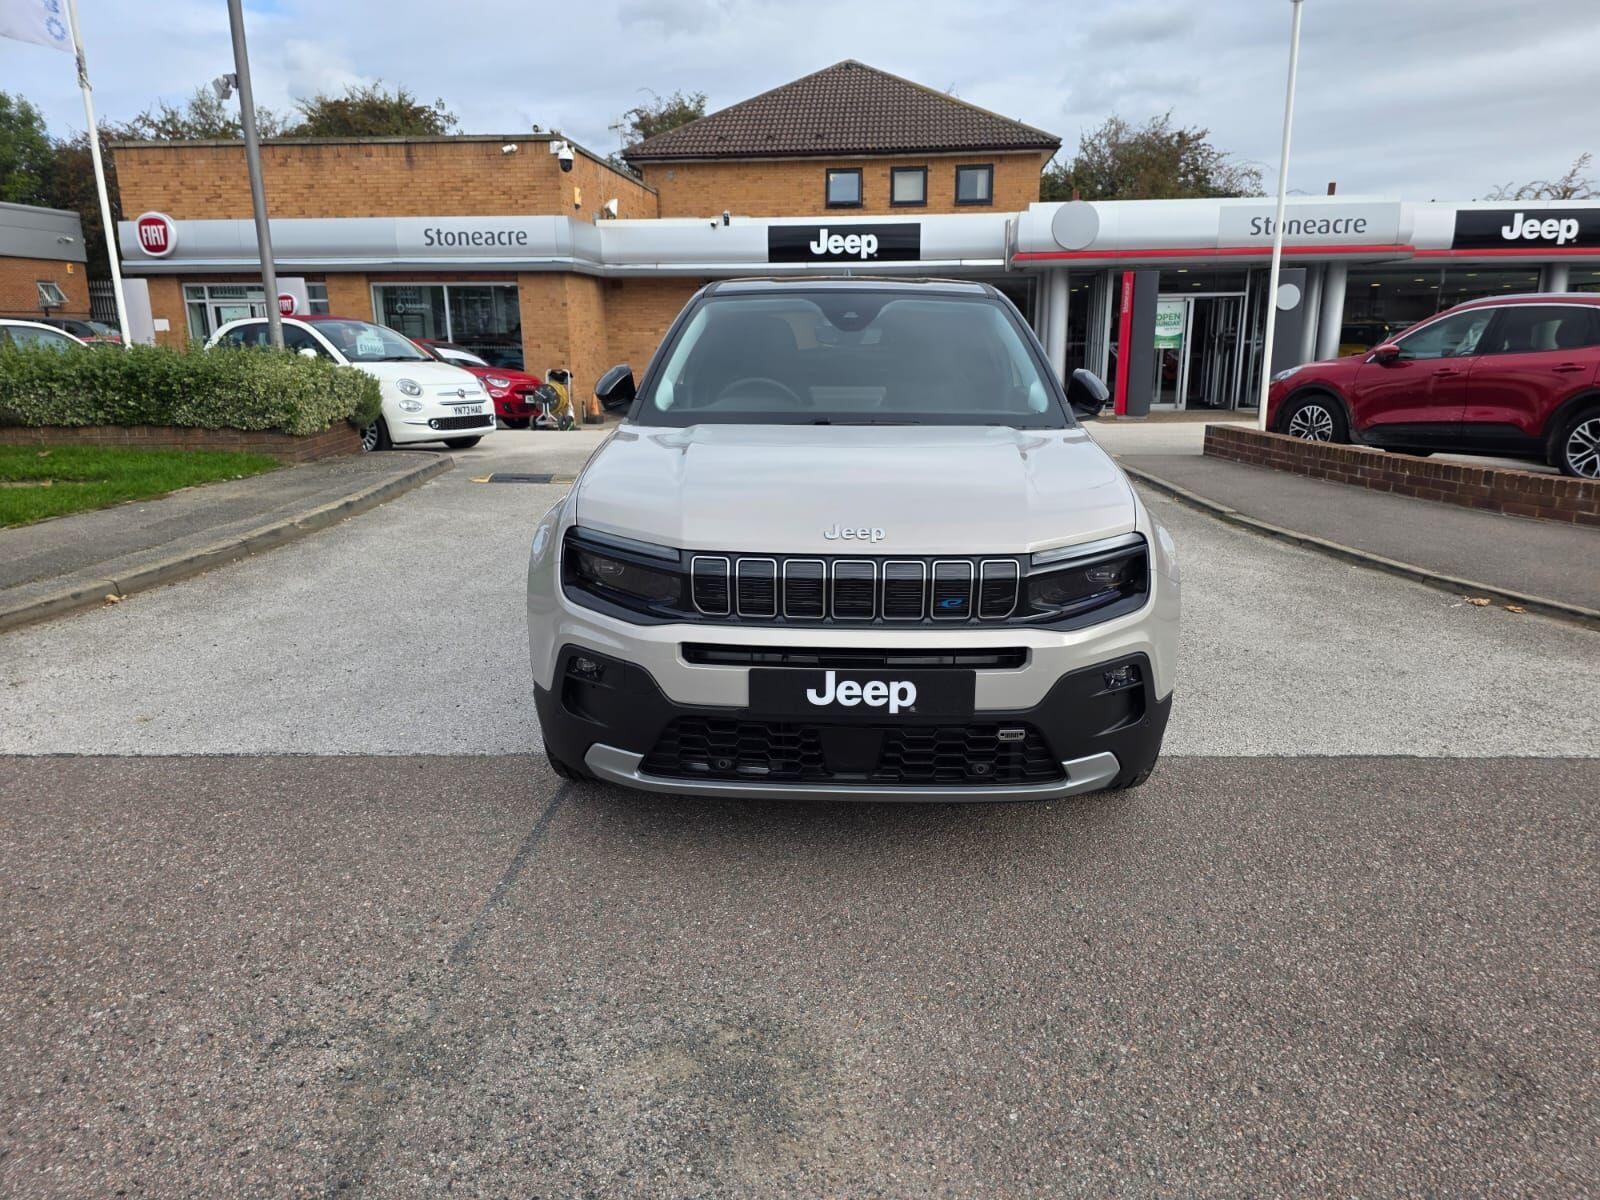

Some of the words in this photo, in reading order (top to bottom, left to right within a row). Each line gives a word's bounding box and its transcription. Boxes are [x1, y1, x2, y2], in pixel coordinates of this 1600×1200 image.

[141, 225, 166, 246] FIAT
[424, 228, 528, 246] Stoneacre
[1501, 212, 1579, 245] Jeep
[809, 228, 878, 259] Jeep
[1156, 312, 1181, 320] OPEN
[453, 405, 469, 416] YN73
[823, 522, 887, 544] Jeep
[806, 670, 917, 714] Jeep
